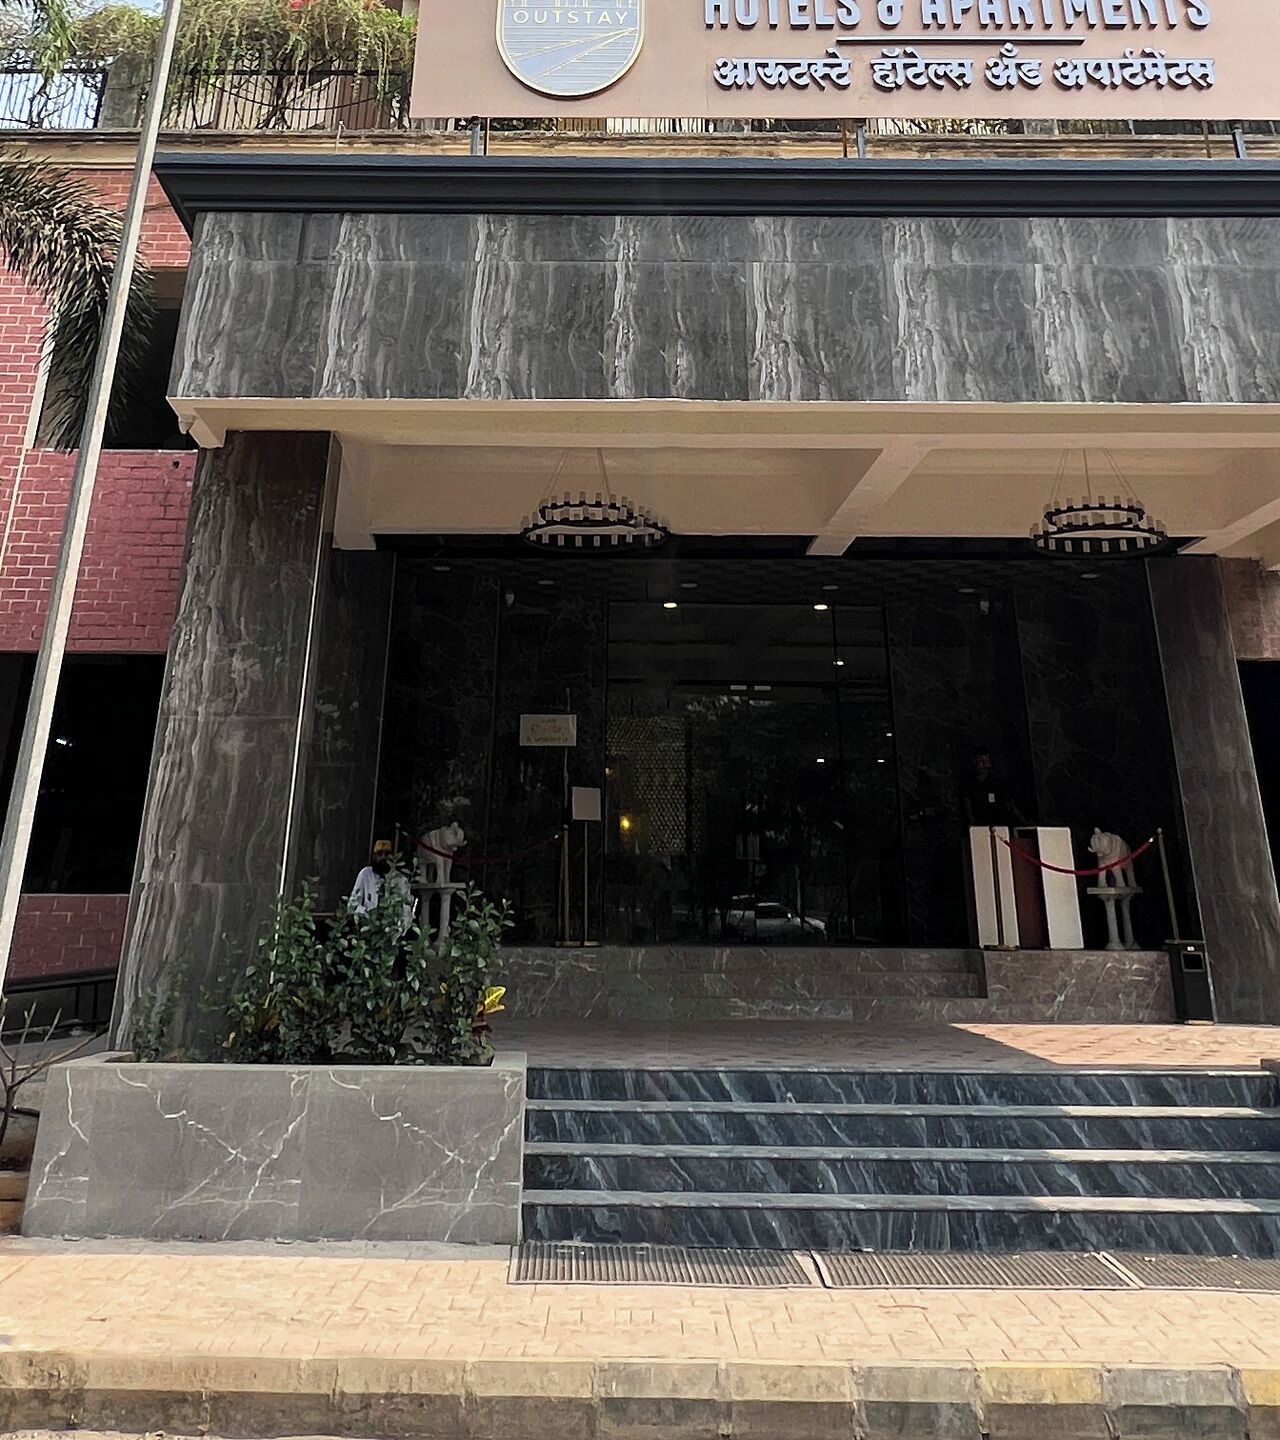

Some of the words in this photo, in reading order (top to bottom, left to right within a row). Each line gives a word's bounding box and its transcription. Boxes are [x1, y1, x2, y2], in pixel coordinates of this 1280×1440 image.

[513, 10, 628, 25] OUTSTAY
[713, 47, 852, 91] आऊटस्टे
[870, 46, 973, 90] हॉटेल्स
[984, 42, 1043, 89] अँड
